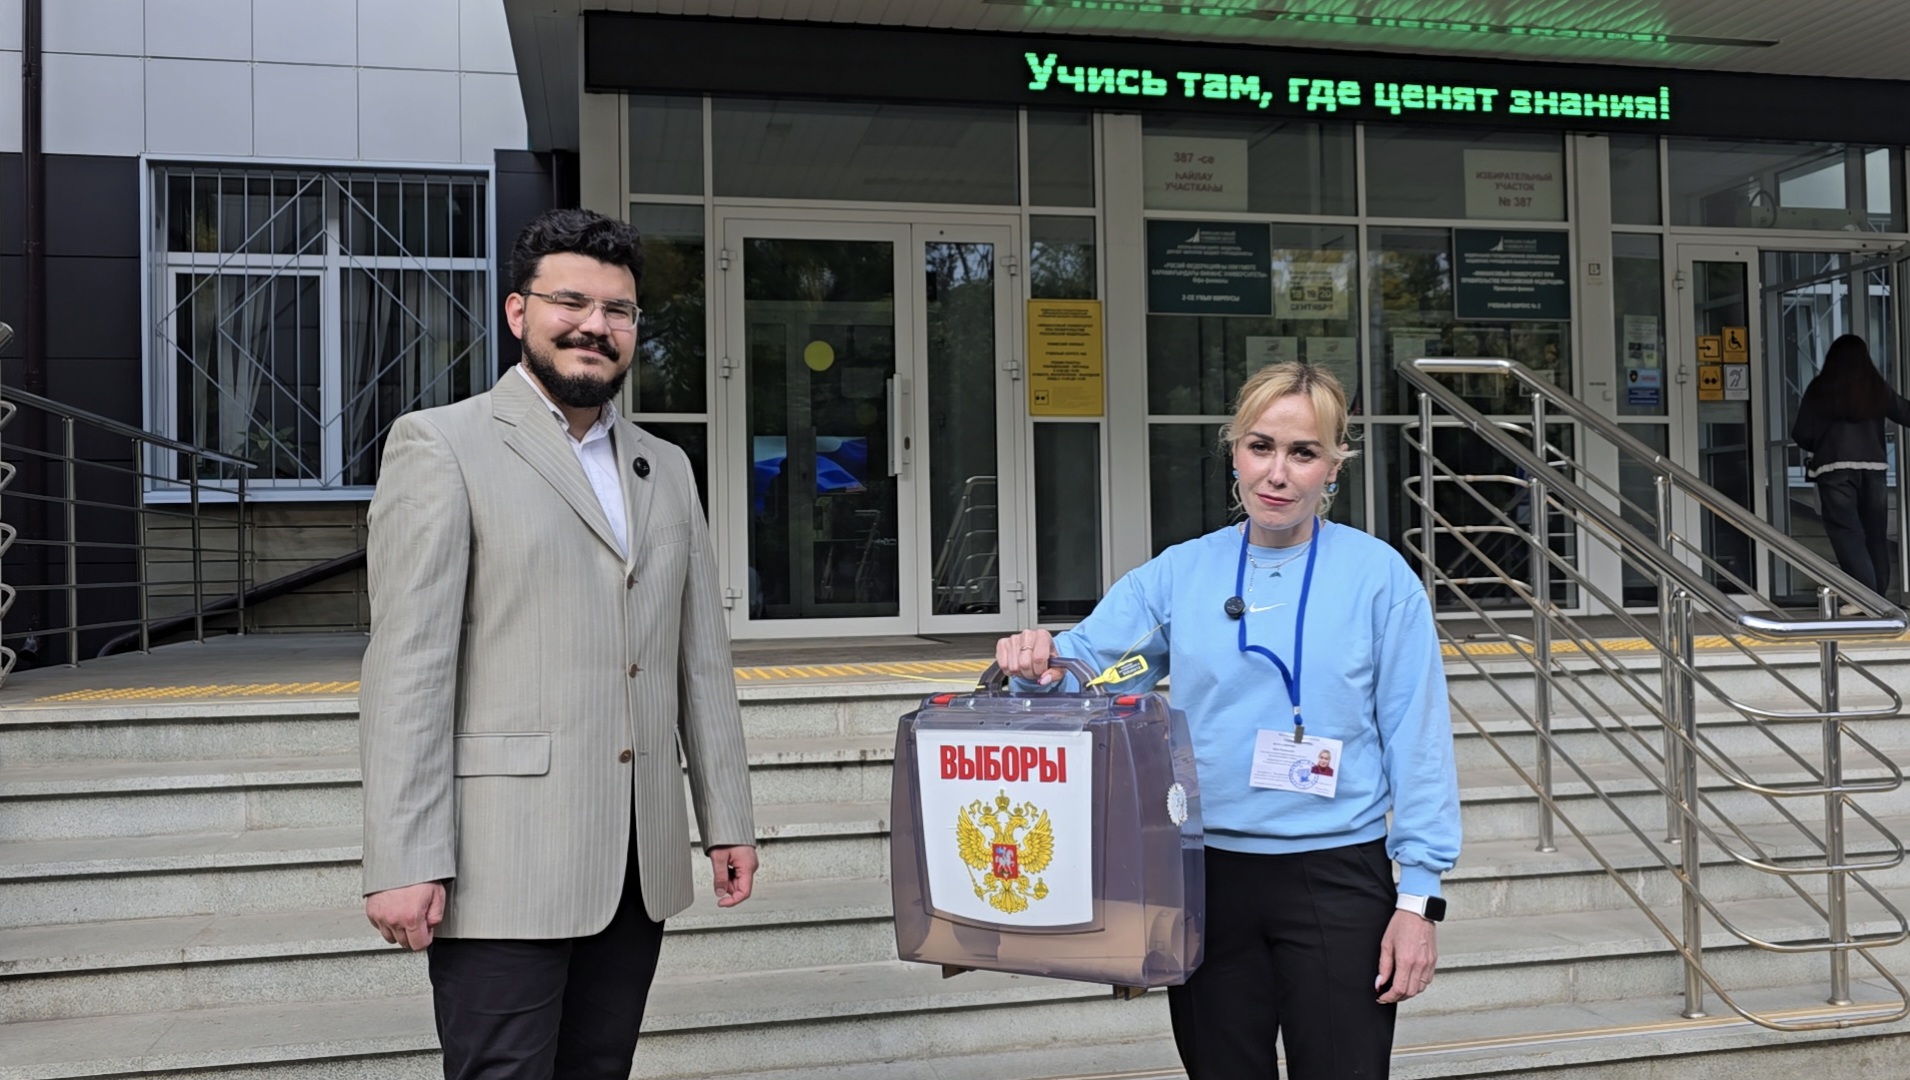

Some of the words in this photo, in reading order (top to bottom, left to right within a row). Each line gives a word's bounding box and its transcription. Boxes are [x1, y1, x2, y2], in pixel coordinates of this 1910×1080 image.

[1024, 52, 1167, 95] Учись
[1176, 71, 1273, 108] там,
[1288, 77, 1361, 111] где
[1374, 82, 1498, 114] ценят
[1509, 86, 1669, 119] знания!
[1173, 152, 1194, 163] 387
[1476, 171, 1553, 182] ИЗБИРАТЕЛЬНЫЙ
[1495, 182, 1535, 191] УЧАСТОК
[1498, 196, 1511, 207] №
[1513, 197, 1533, 207] 387
[1319, 289, 1332, 299] 20
[939, 745, 1067, 783] ВЫБОРЫ
